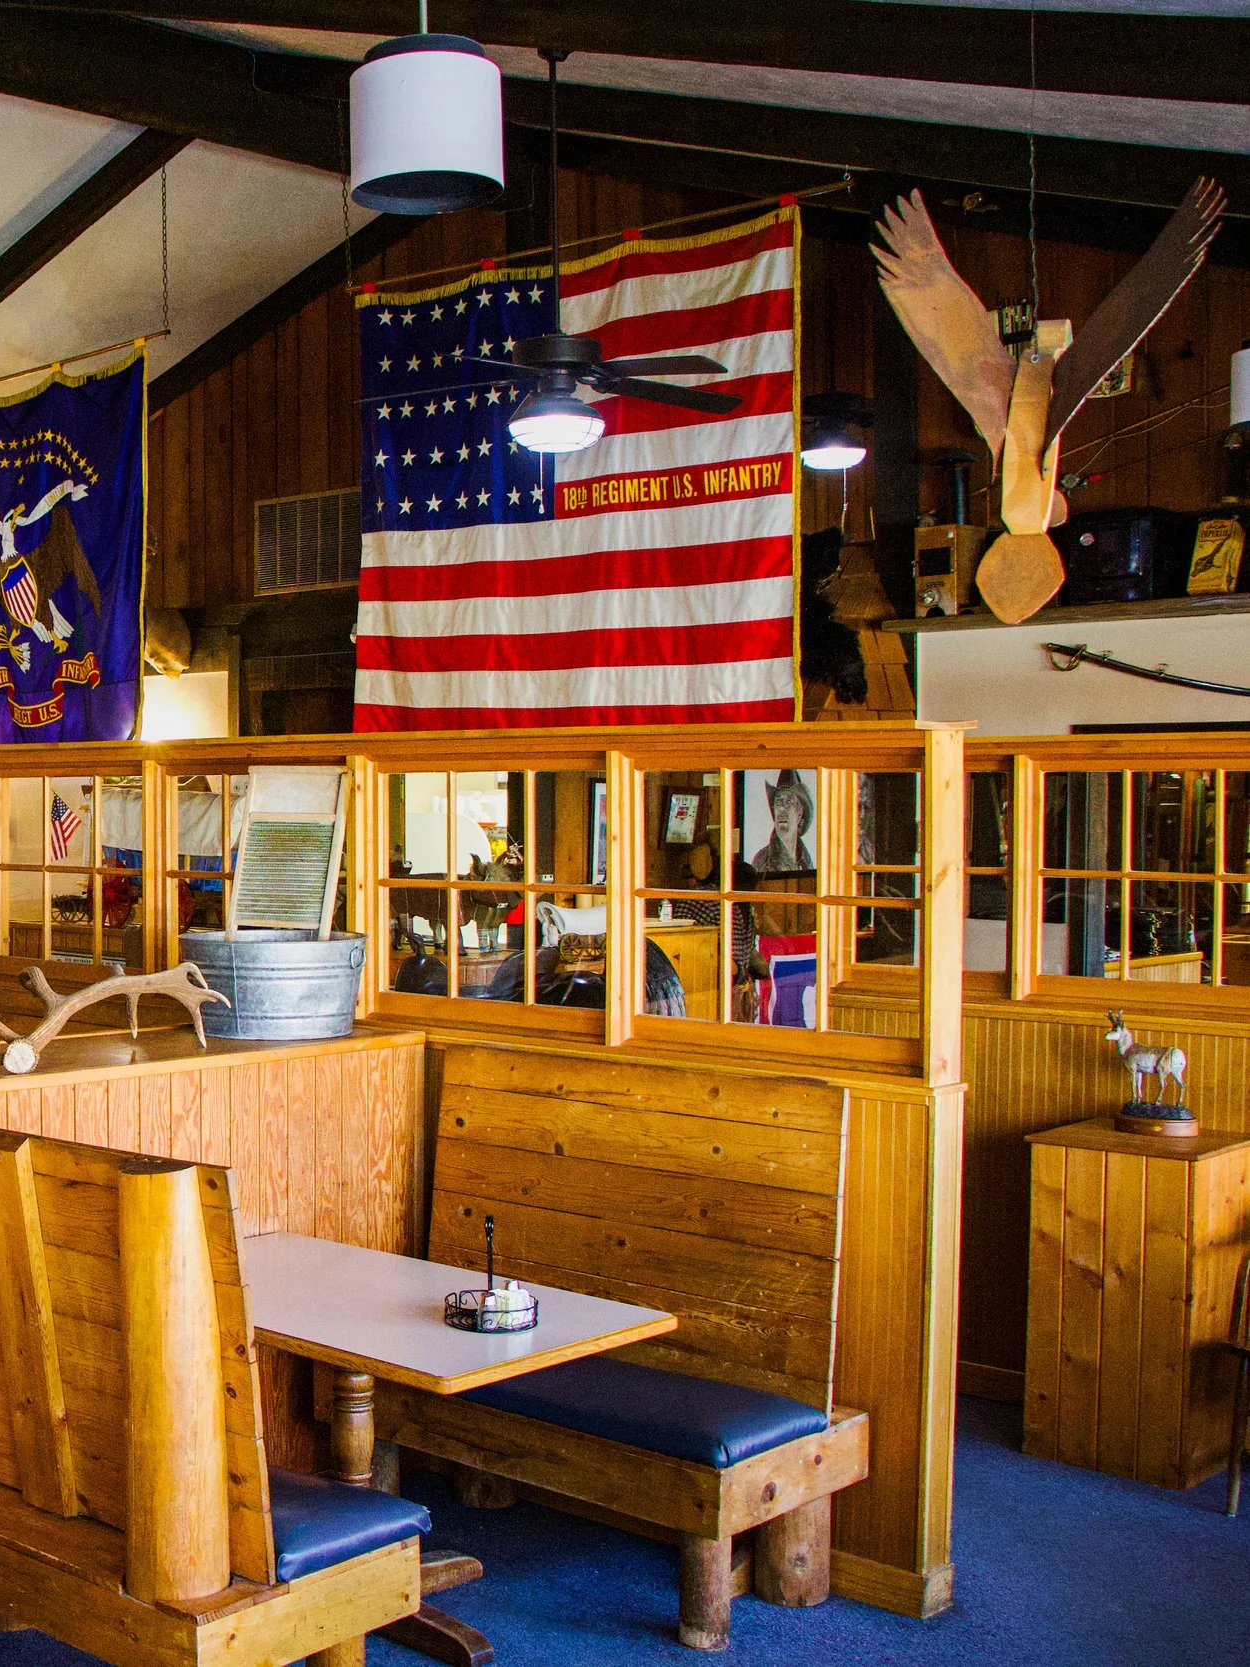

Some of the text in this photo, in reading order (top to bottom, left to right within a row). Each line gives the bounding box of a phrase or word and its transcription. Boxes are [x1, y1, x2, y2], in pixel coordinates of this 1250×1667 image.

[592, 476, 669, 507] REGIMENT
[672, 473, 698, 499] U.S.
[704, 461, 782, 496] INFANTRY
[38, 704, 60, 721] U.S.
